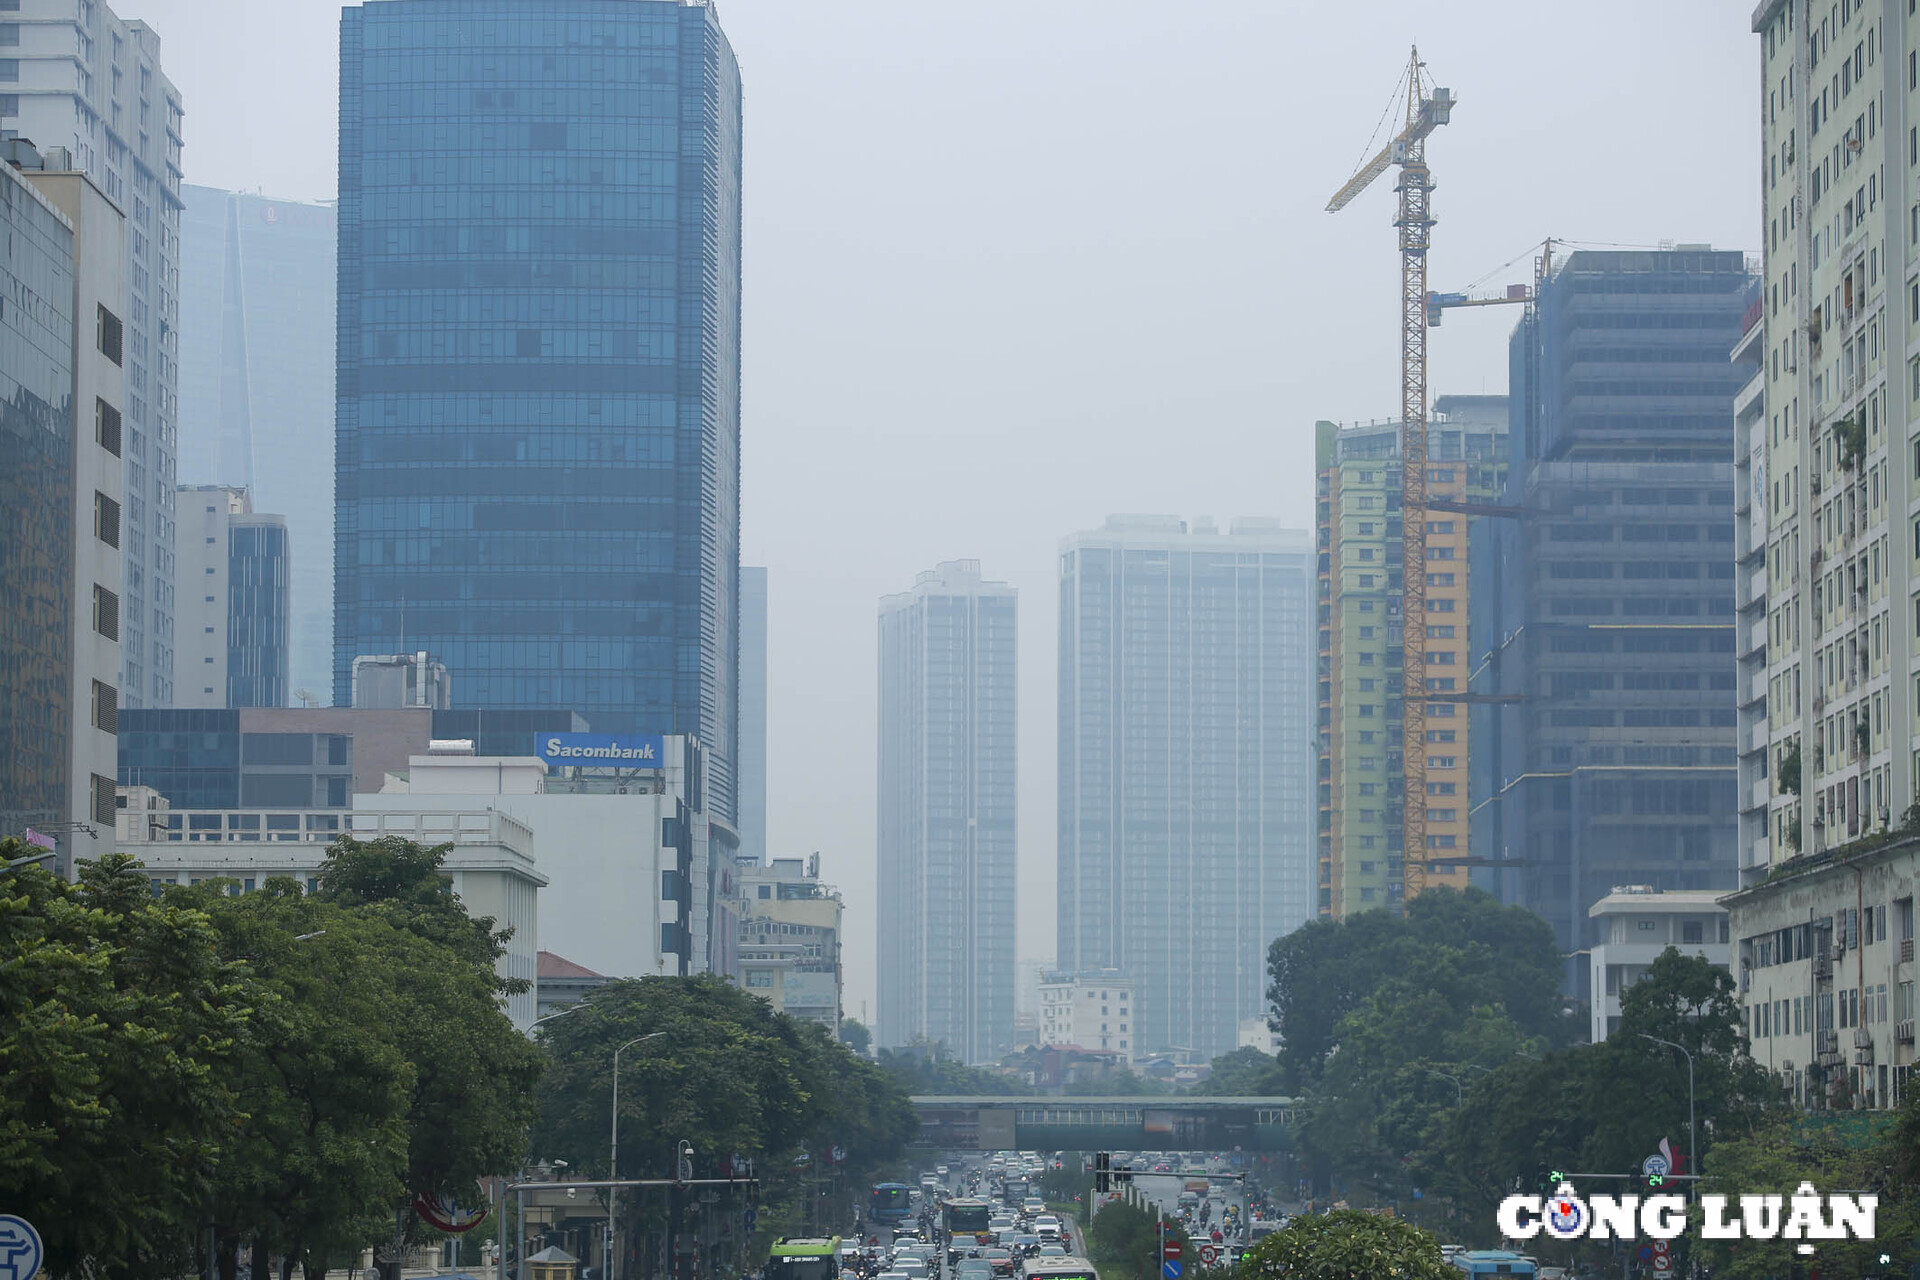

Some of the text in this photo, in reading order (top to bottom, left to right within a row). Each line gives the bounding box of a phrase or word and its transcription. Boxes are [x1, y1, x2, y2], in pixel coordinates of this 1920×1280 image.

[546, 738, 656, 760] Sacombank
[1550, 1171, 1564, 1183] 24
[1649, 1174, 1663, 1186] 24
